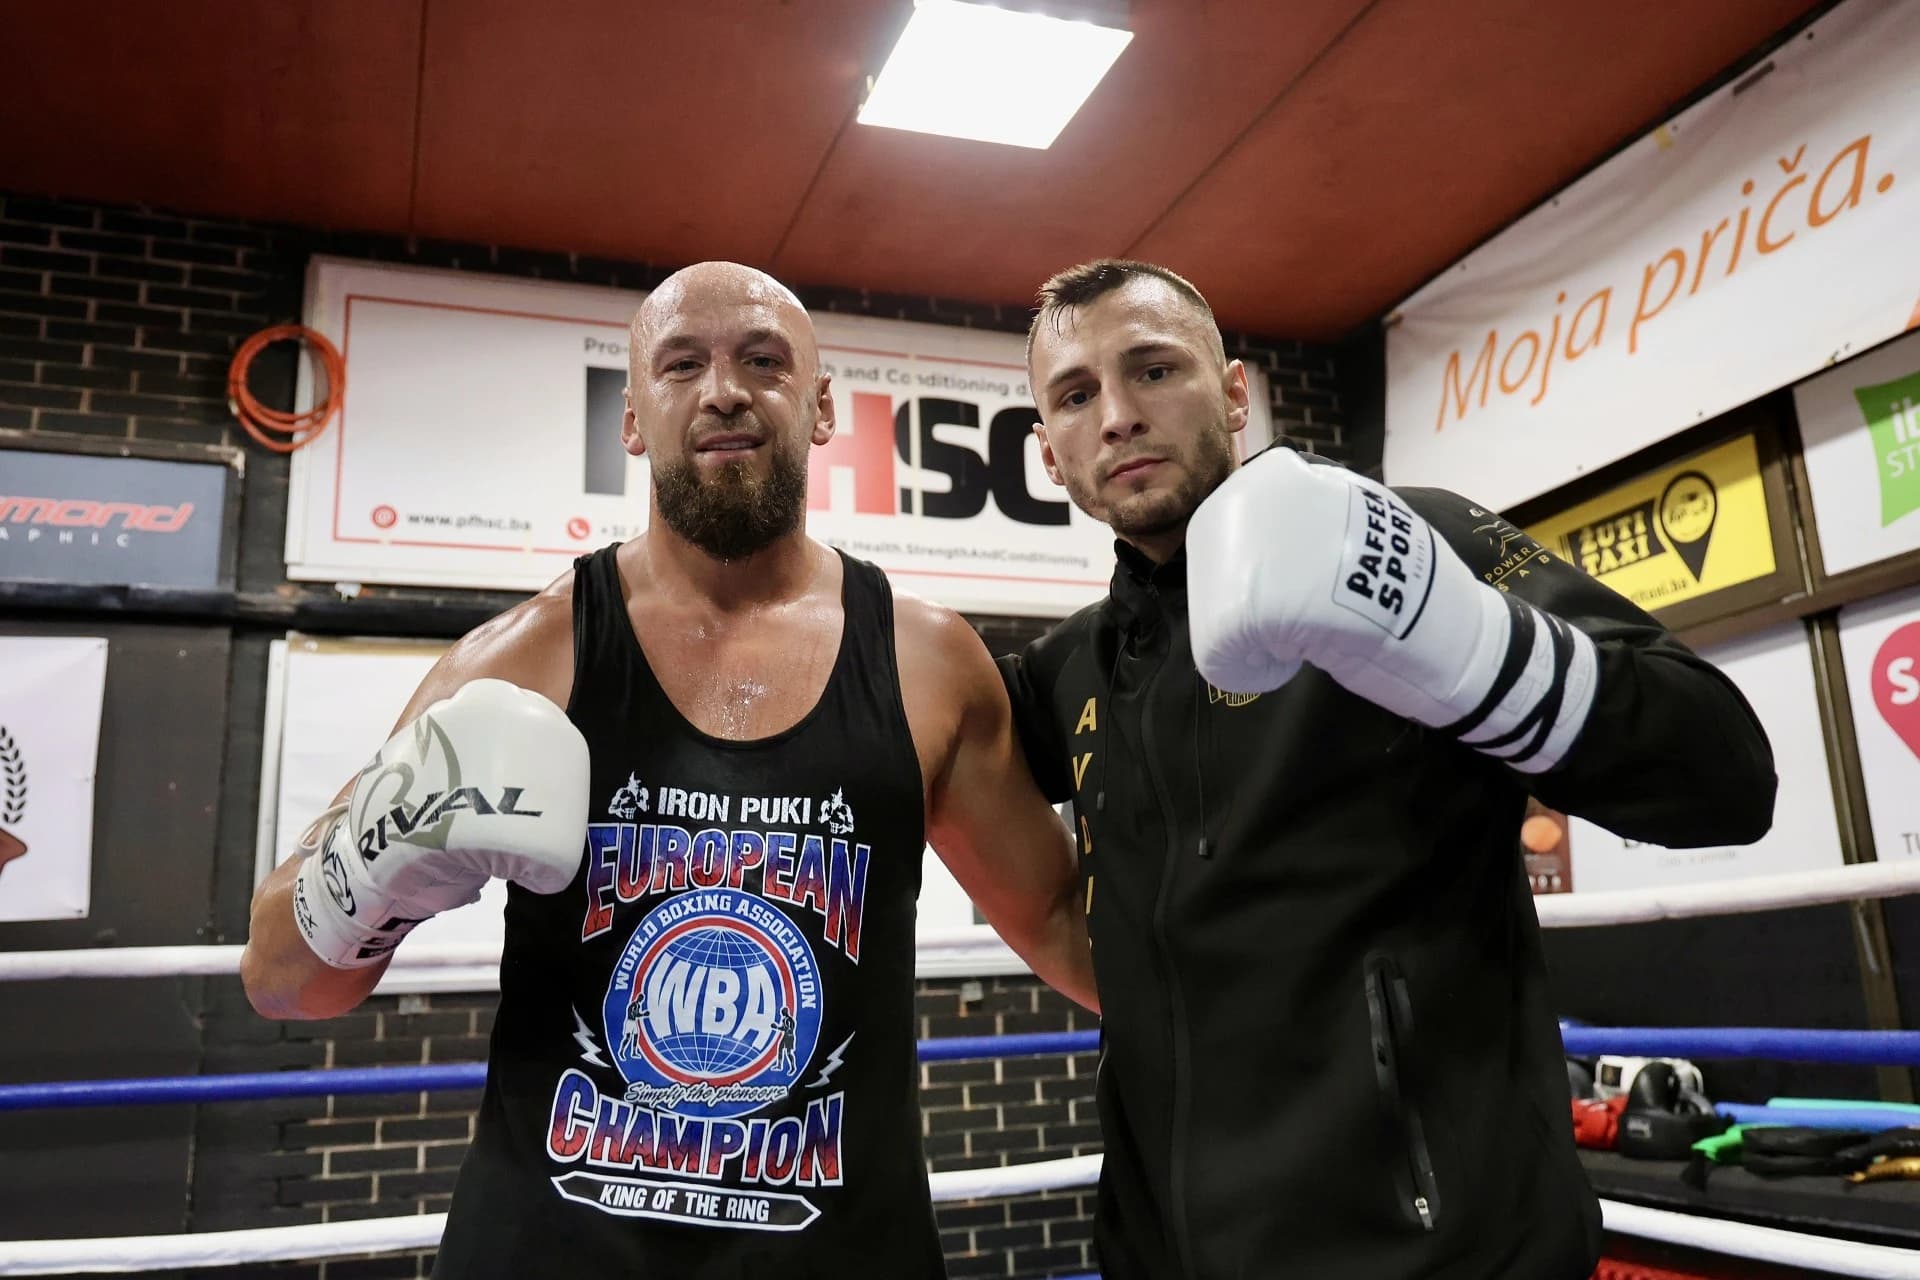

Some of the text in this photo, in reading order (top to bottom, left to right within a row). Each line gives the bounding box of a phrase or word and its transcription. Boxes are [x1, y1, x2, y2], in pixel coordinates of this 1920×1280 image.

[1436, 134, 1895, 432] Moja priča.
[843, 367, 880, 381] and
[0, 495, 195, 533] mond
[1346, 489, 1387, 600] PAFFEN
[1378, 499, 1414, 616] SPORT
[1484, 546, 1531, 583] POWER
[1581, 533, 1650, 577] TAXI
[1886, 656, 1920, 705] S
[357, 786, 544, 862] RIVAL
[657, 786, 811, 825] IRON PUKI
[581, 822, 871, 966] EUROPEAN
[614, 894, 817, 1010] WORLD BOXING ASSOCIATION
[646, 949, 777, 1050] WBA
[624, 1080, 790, 1110] Simply the pioneers
[546, 1067, 845, 1188] CHAMPION
[600, 1183, 770, 1222] KING OF THE RING
